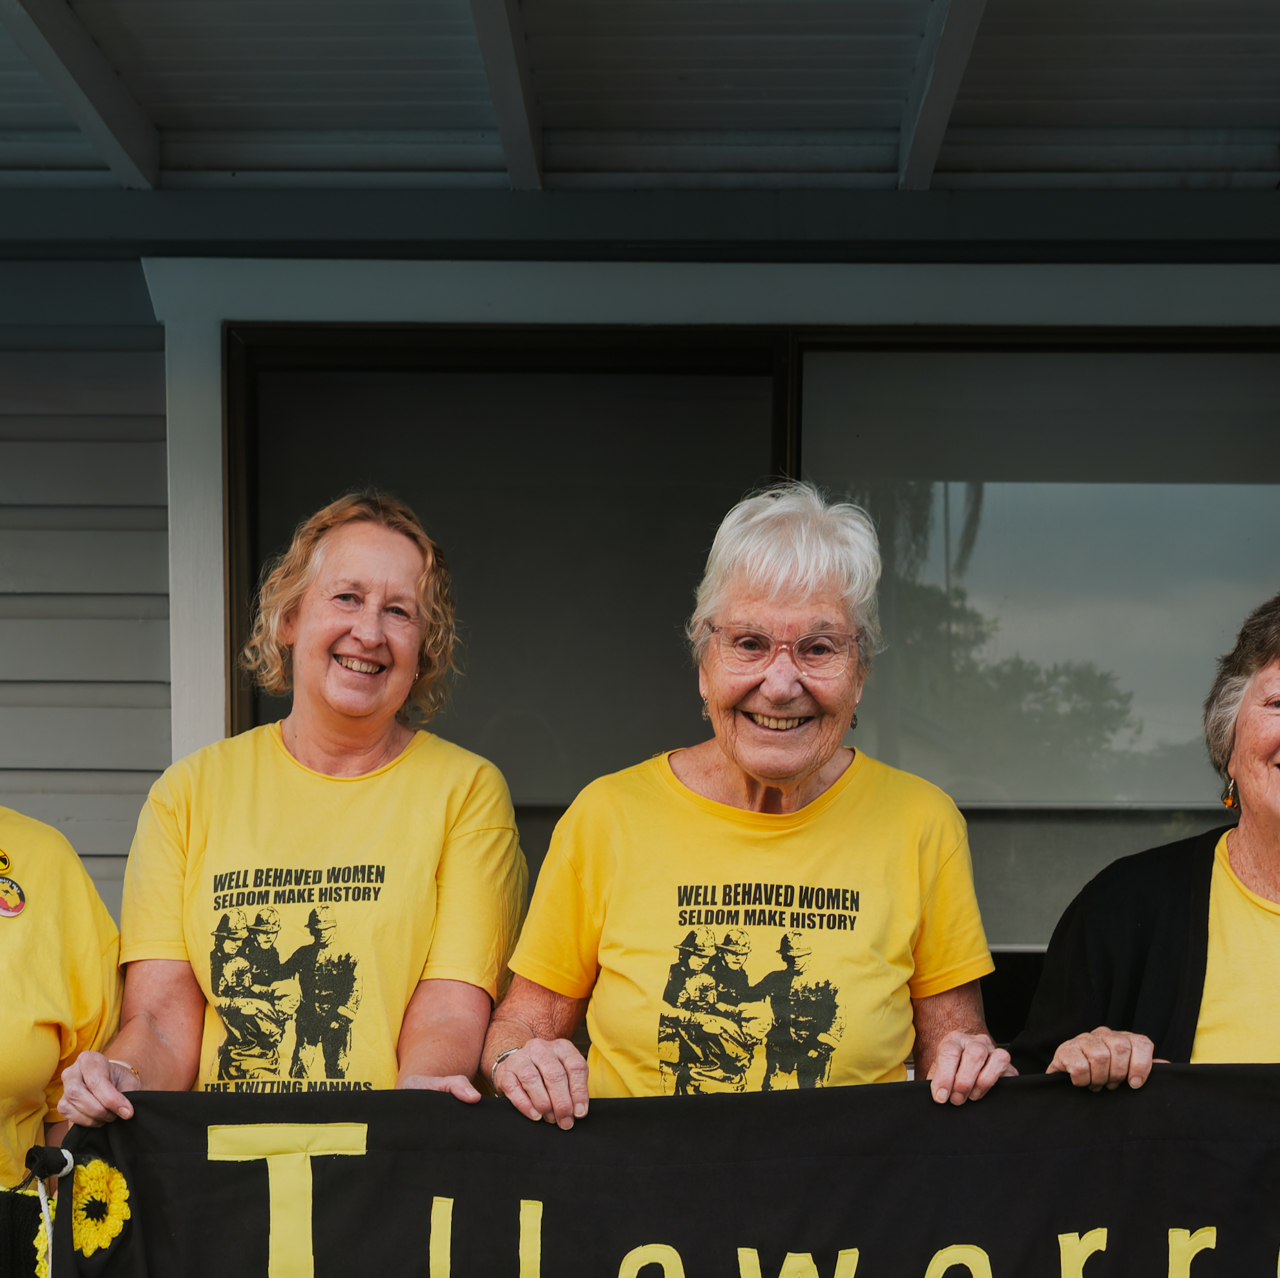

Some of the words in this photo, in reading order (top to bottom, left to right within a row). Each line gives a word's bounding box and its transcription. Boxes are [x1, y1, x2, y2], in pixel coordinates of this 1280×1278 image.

[213, 870, 249, 893] WELL
[252, 868, 323, 888] BEHAVED
[327, 865, 386, 885] WOMEN
[213, 889, 270, 911] SELDOM
[273, 888, 315, 904] MAKE
[318, 886, 382, 903] HISTORY
[677, 885, 718, 907] WELL
[722, 883, 795, 908] BEHAVED
[799, 885, 860, 912] WOMEN
[678, 909, 740, 926] SELDOM
[743, 909, 786, 928] MAKE
[789, 912, 857, 931] HISTORY
[204, 1082, 230, 1093] THE
[235, 1080, 303, 1093] KNITTING
